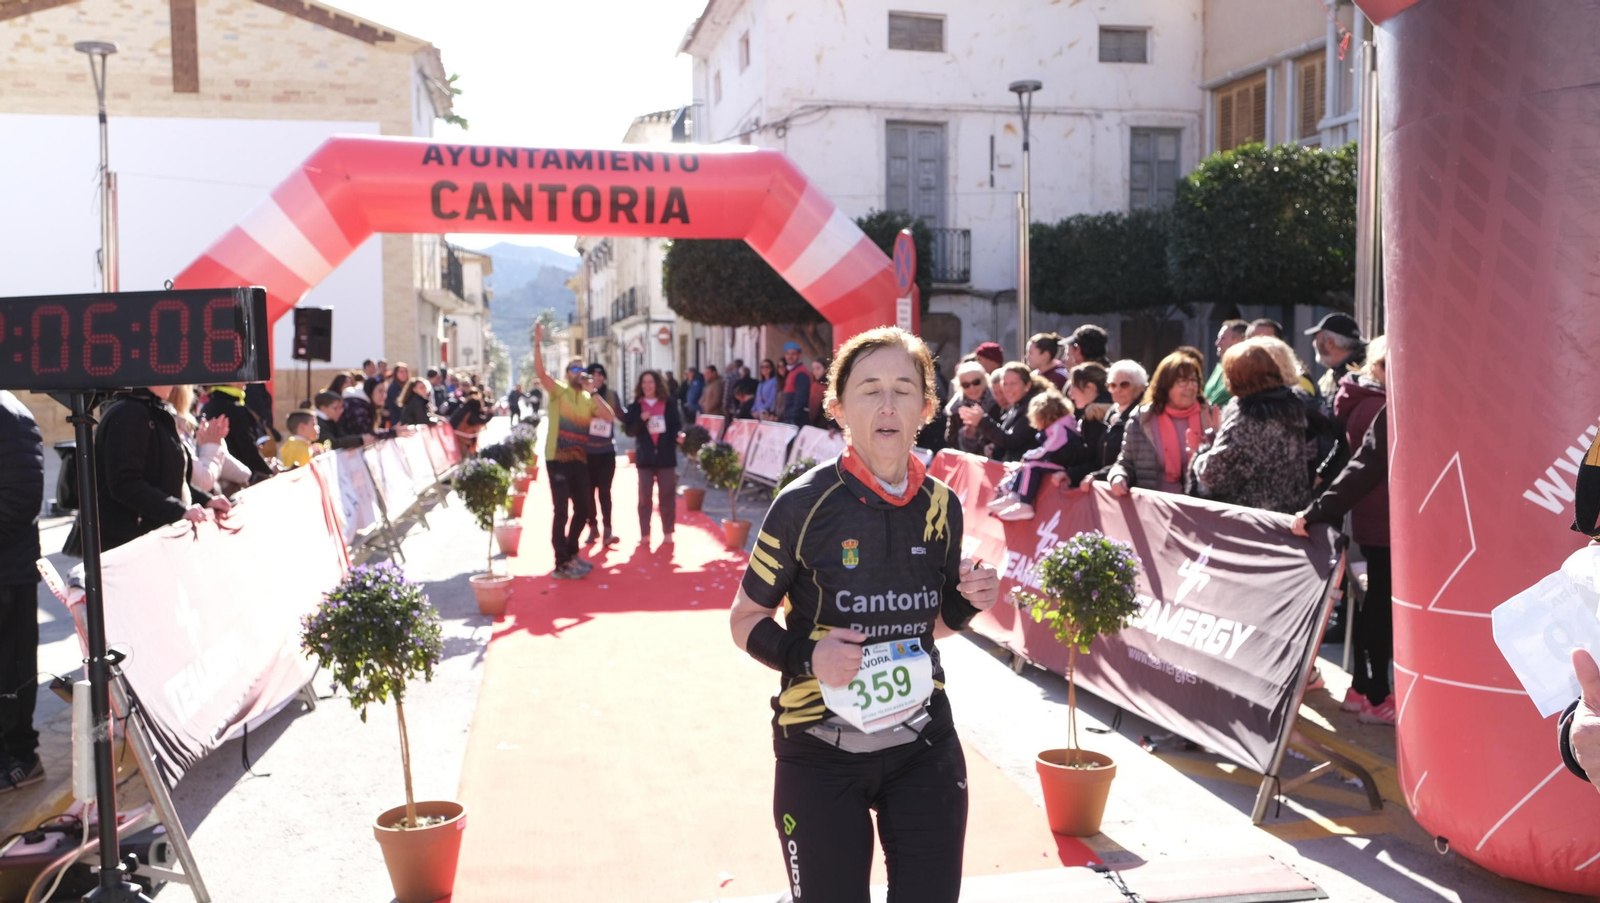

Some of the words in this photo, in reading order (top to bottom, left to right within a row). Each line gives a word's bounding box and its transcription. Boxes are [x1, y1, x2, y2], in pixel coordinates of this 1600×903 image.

[422, 144, 700, 172] AYUNTAMIENTO
[430, 179, 691, 225] CANTORIA
[835, 585, 939, 614] Cantoria
[847, 665, 912, 711] 359
[787, 839, 802, 899] sano
